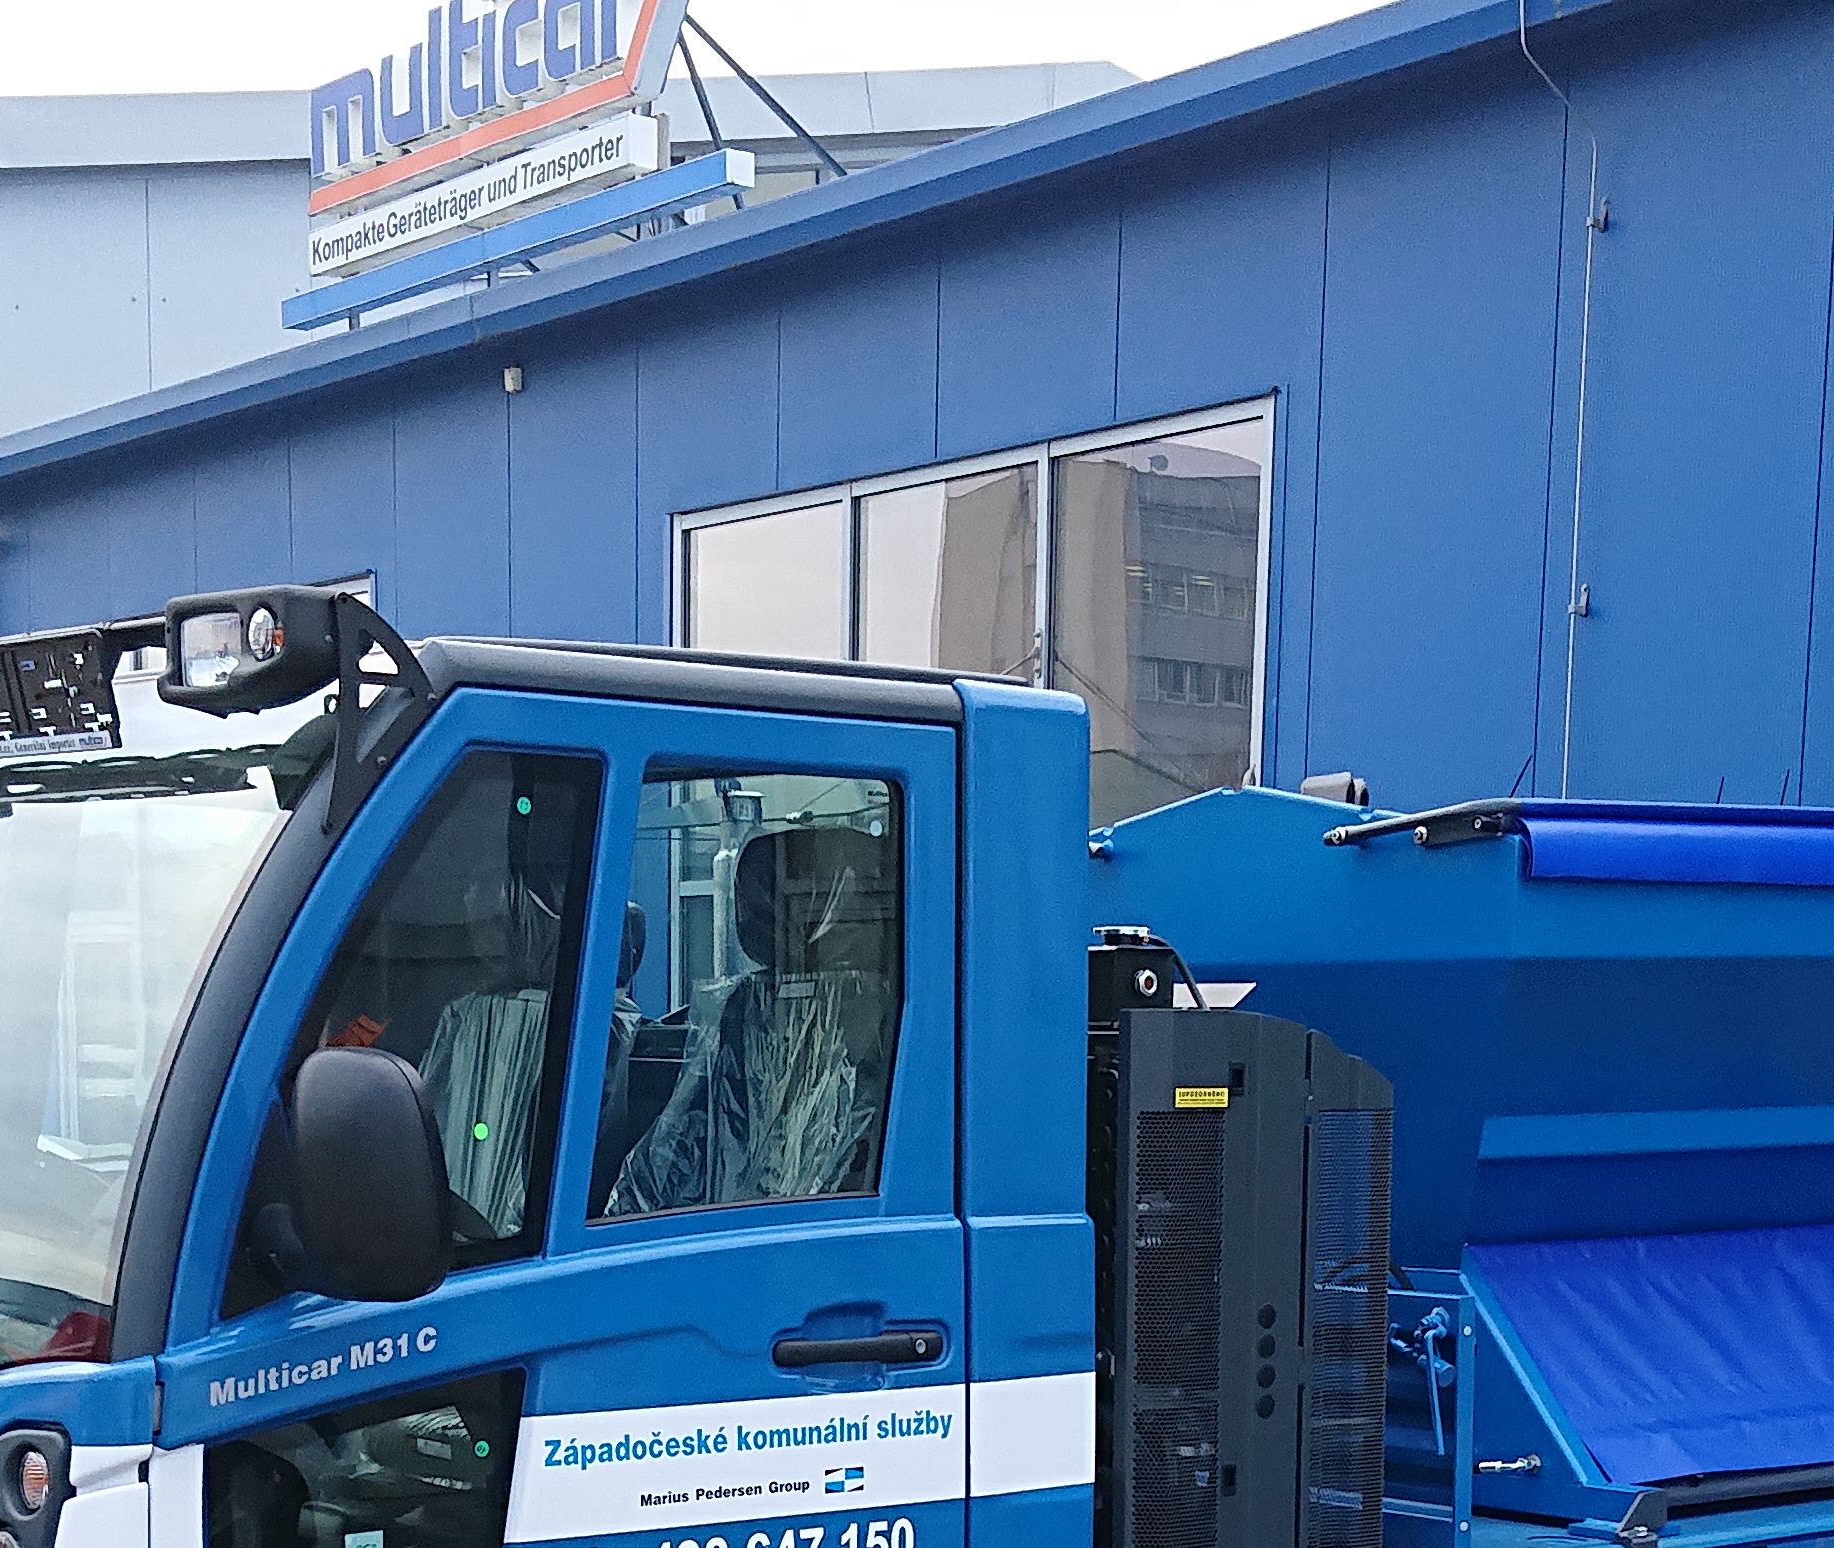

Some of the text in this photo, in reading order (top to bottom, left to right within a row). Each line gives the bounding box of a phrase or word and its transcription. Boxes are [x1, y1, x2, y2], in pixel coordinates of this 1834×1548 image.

[312, 131, 624, 265] Kompakte Geräteträger und Transporter
[209, 1355, 343, 1407] Multicar
[544, 1409, 953, 1471] Západočeské komunální služby
[640, 1477, 810, 1507] Marius Pedersen Group
